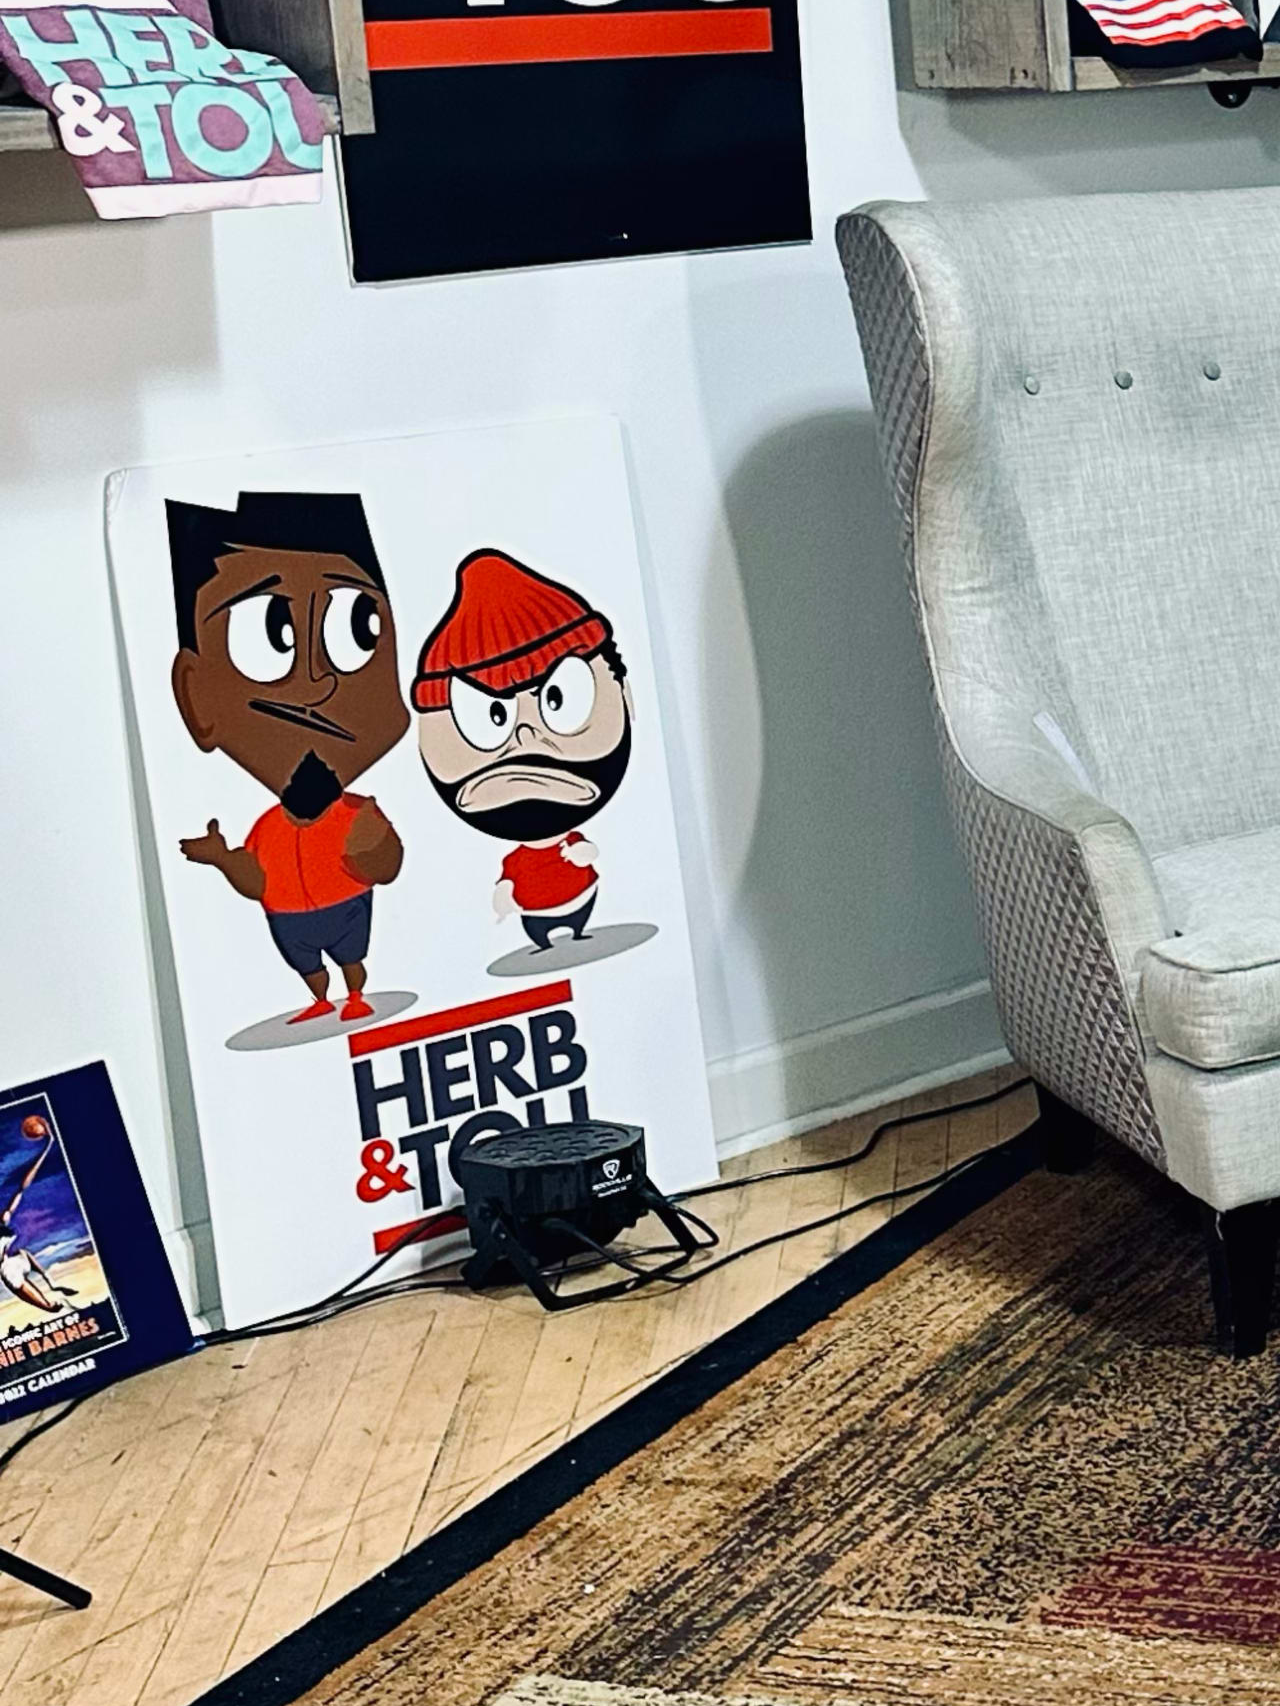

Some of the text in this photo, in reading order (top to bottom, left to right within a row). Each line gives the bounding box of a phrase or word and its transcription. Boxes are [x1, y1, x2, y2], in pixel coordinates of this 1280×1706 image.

[353, 1010, 587, 1141] HERB
[356, 1086, 590, 1210] &TO
[28, 1317, 100, 1357] BARNES
[44, 1319, 63, 1334] ART
[65, 1313, 80, 1326] OF
[27, 1357, 96, 1392] CALENDAR
